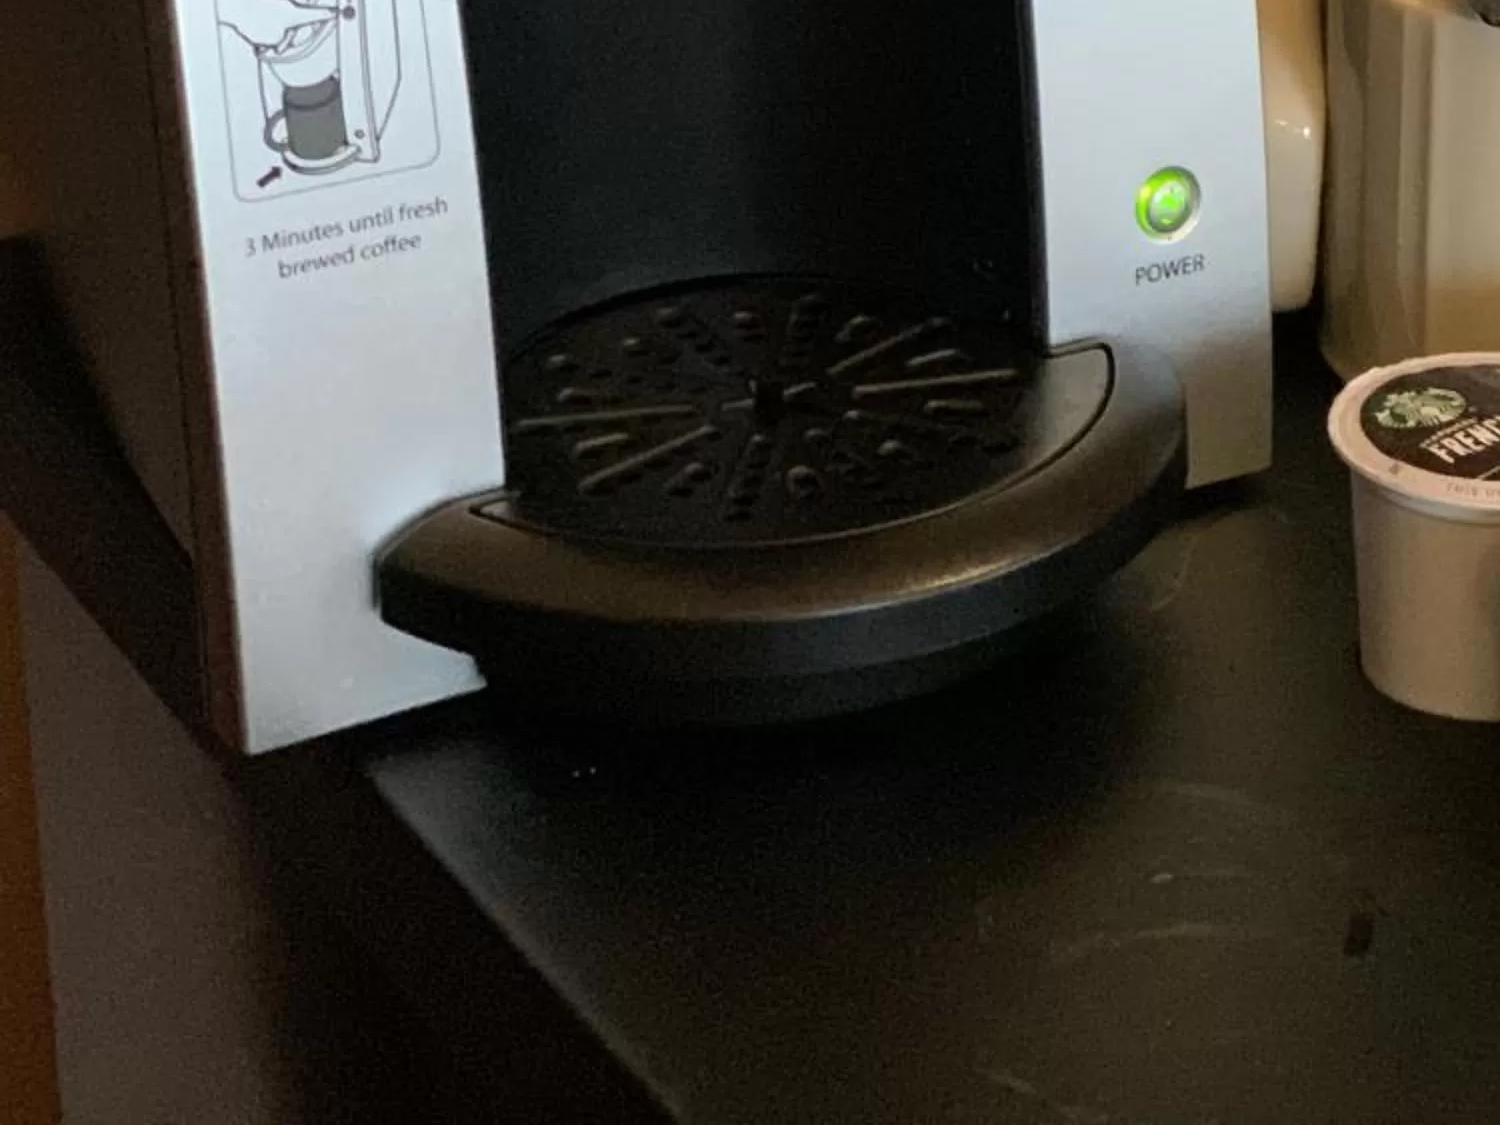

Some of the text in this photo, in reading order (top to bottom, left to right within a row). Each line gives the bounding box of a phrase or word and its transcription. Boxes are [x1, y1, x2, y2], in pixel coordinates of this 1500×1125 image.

[244, 196, 449, 258] 3 Minutes until fresh
[277, 233, 423, 278] brewed coffee
[1135, 253, 1206, 286] POWER
